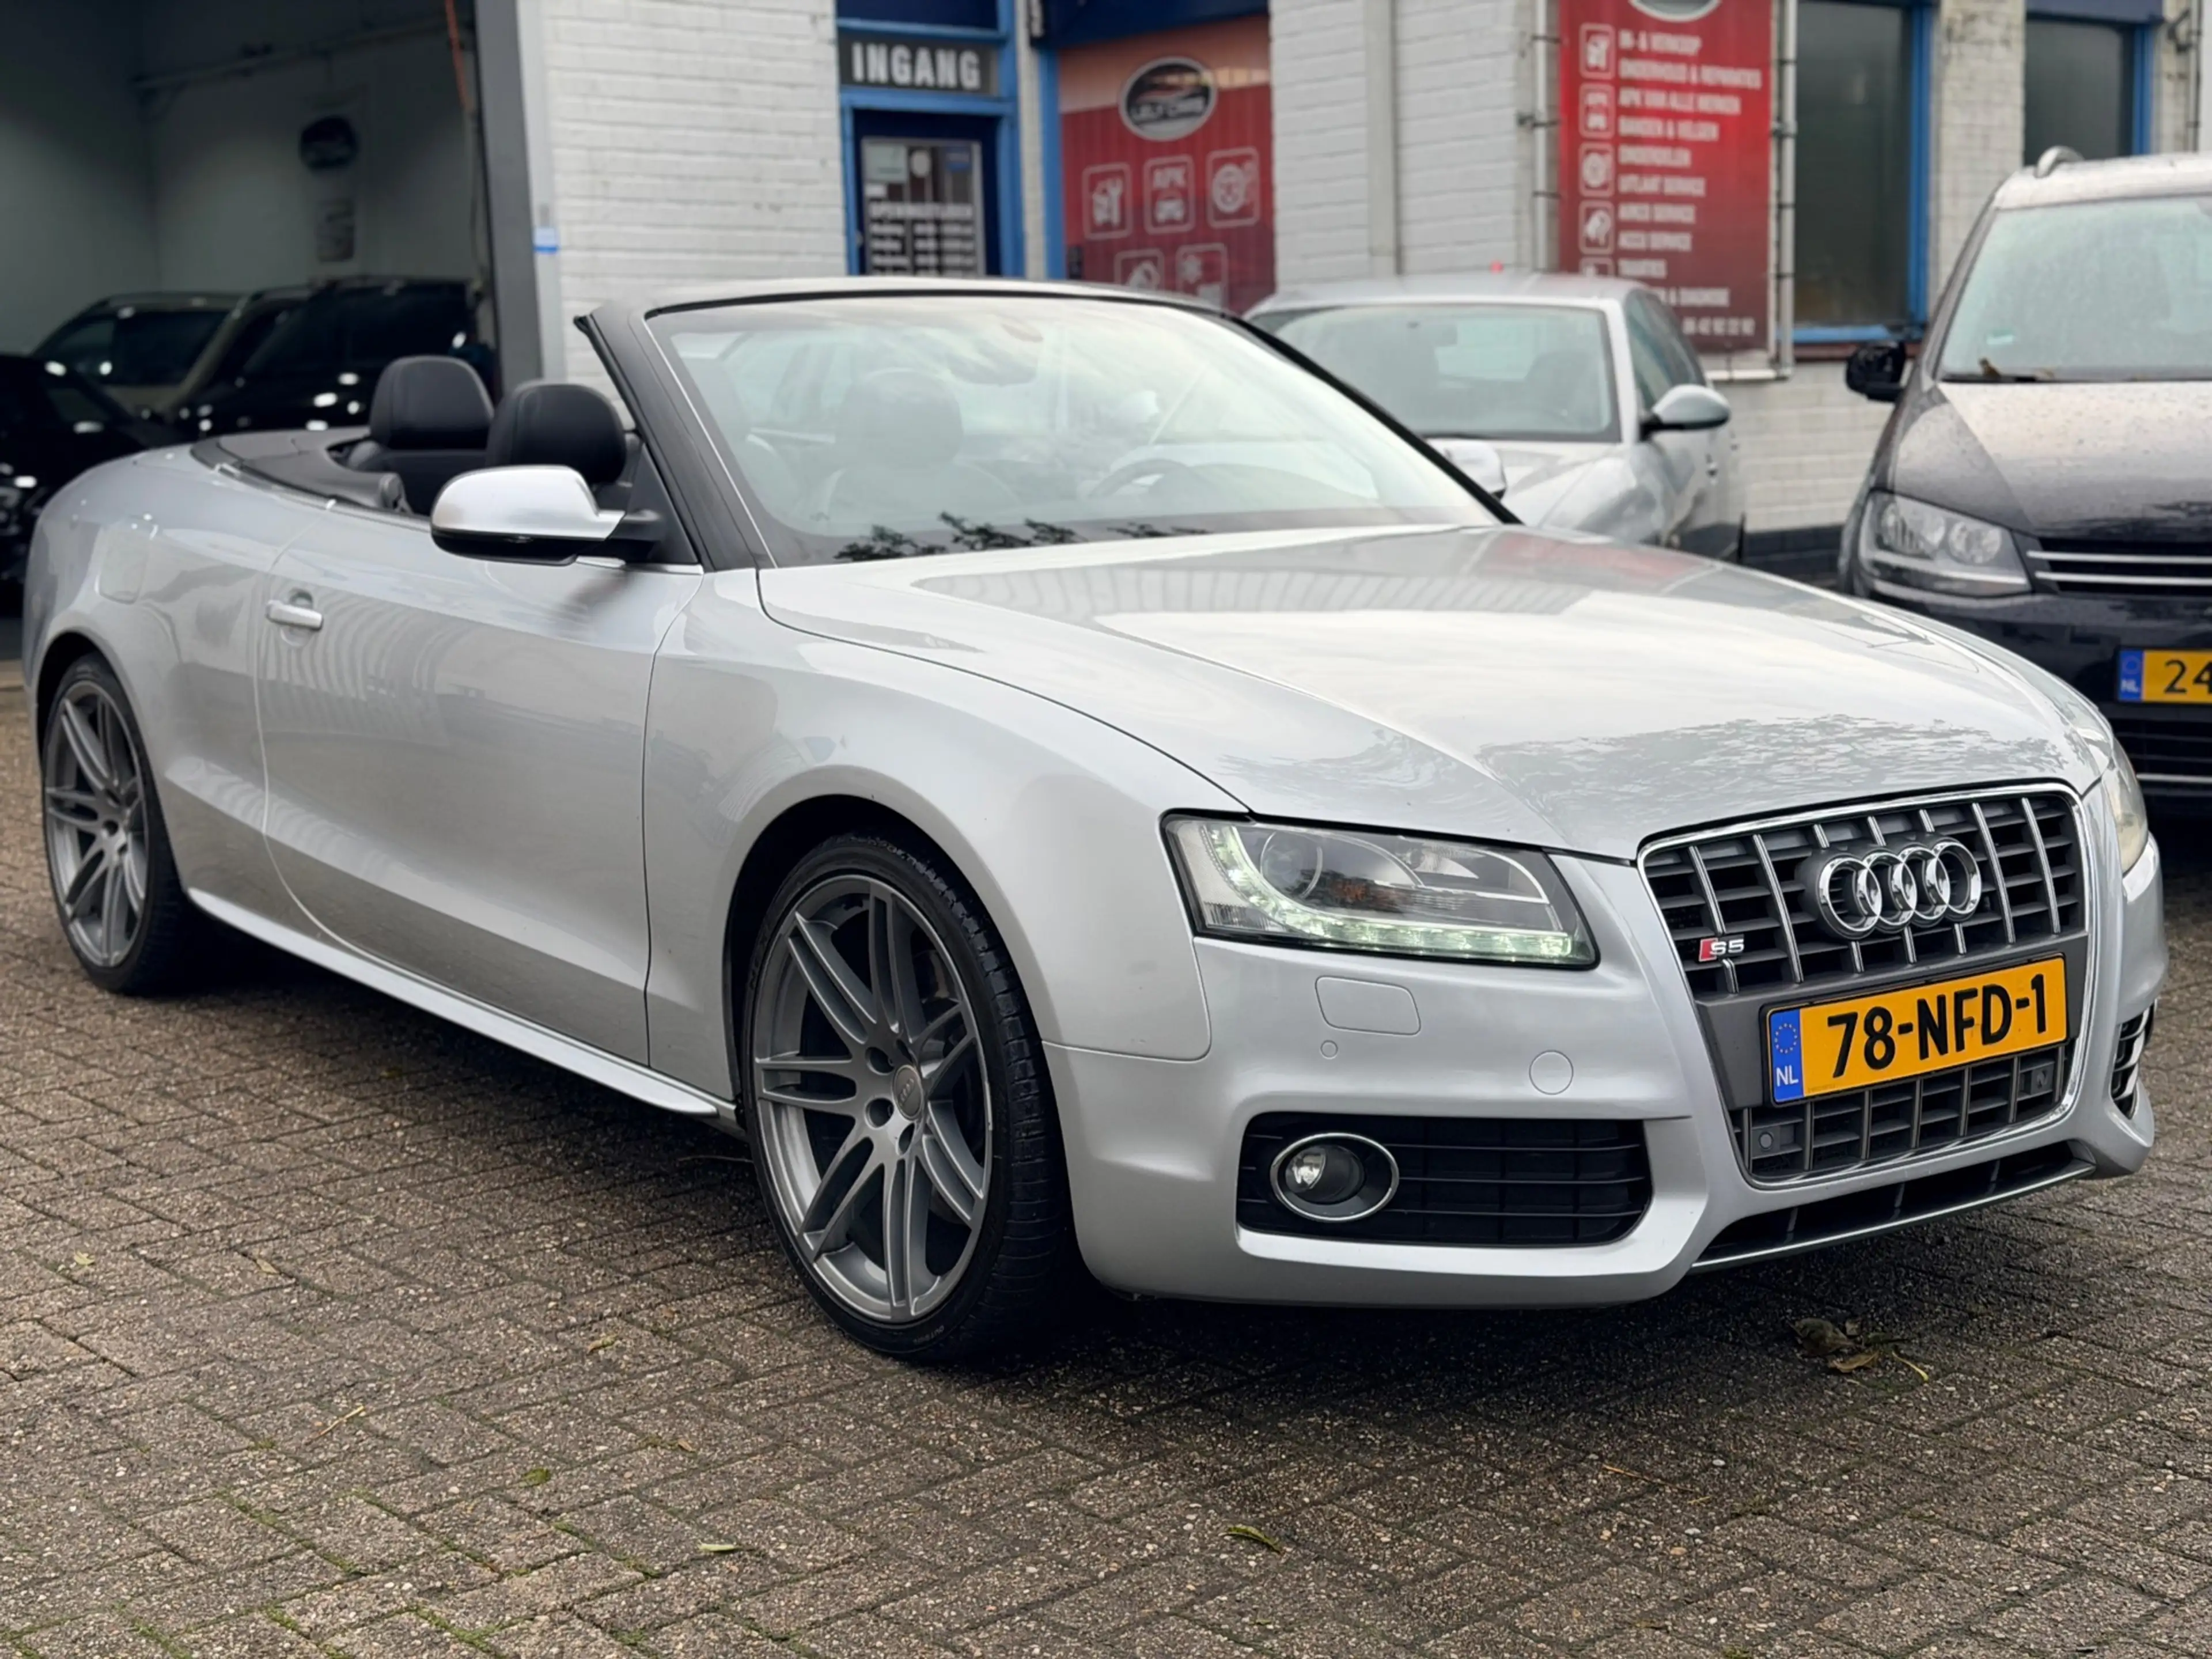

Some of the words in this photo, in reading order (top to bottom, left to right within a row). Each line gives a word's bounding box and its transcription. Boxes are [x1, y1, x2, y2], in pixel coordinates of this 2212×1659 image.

[852, 41, 980, 91] INGANG
[1709, 938, 1745, 955] S5
[1827, 974, 2047, 1078] 78-NFD-1
[1776, 1065, 1799, 1087] NL
